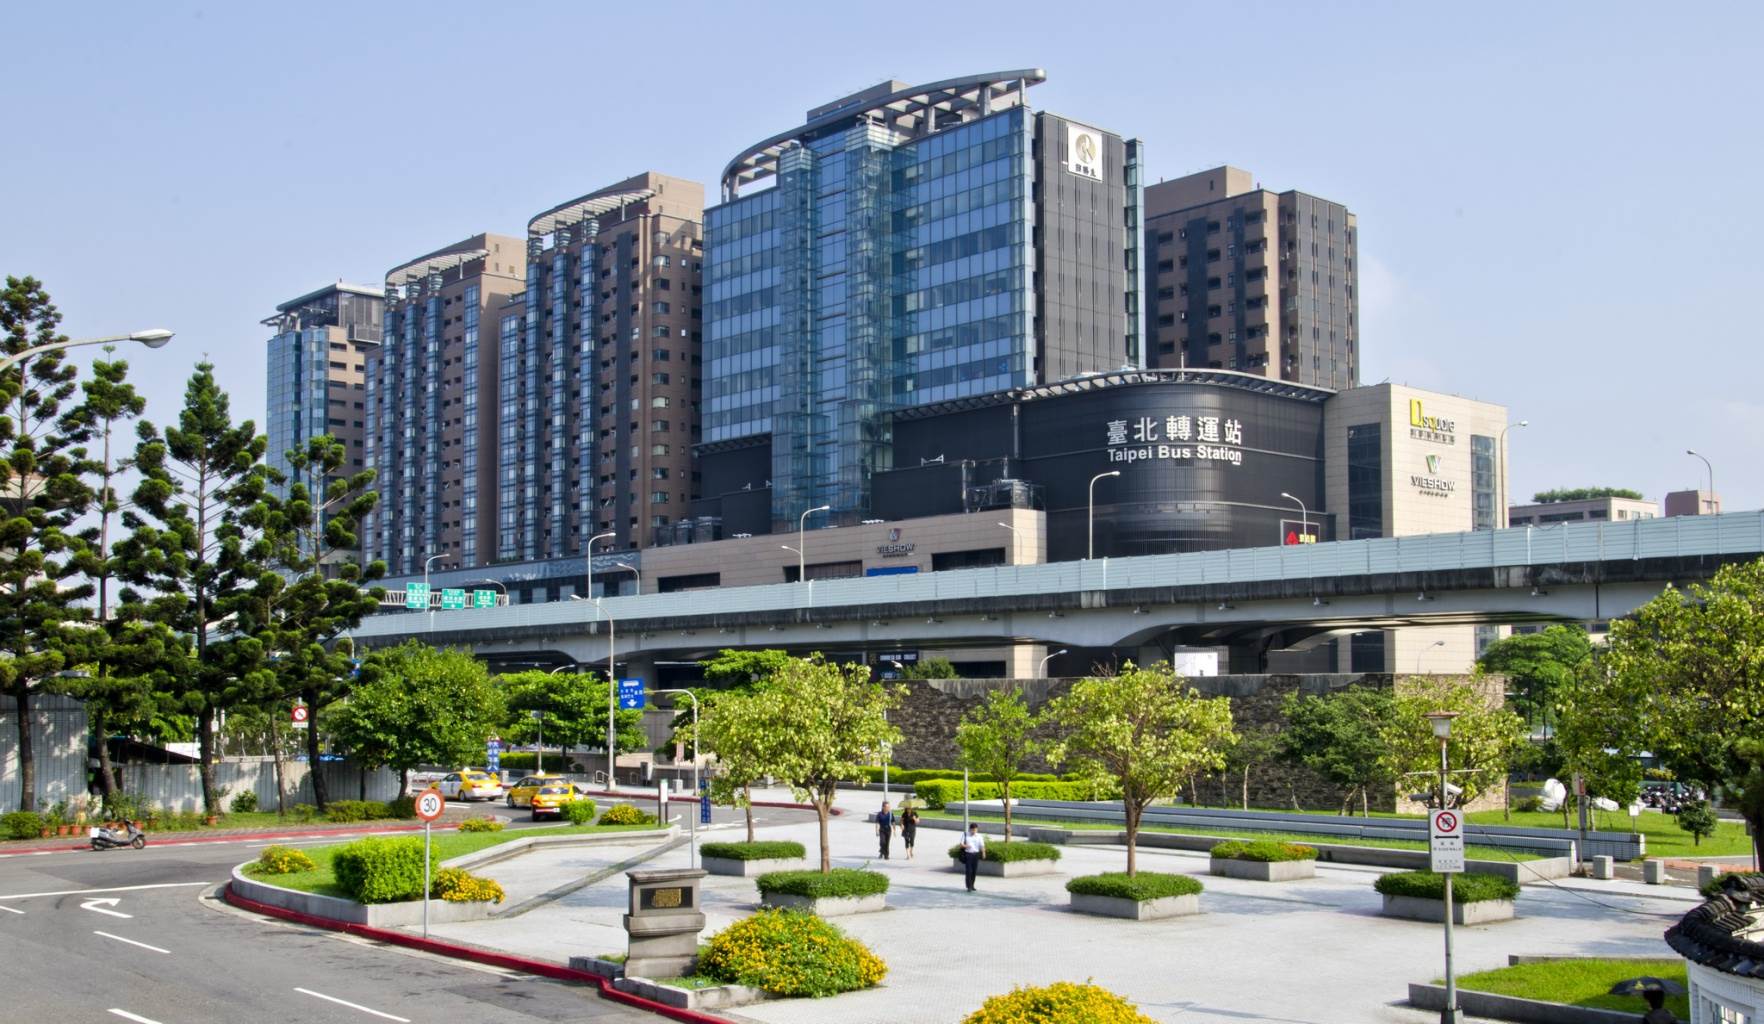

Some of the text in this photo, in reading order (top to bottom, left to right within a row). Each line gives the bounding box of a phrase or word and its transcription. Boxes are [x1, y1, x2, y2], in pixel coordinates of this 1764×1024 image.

[1107, 415, 1242, 445] 臺北轉運站
[1107, 445, 1242, 463] Taipei Bus Station
[1410, 475, 1455, 491] VIESHOW
[423, 797, 437, 813] 30
